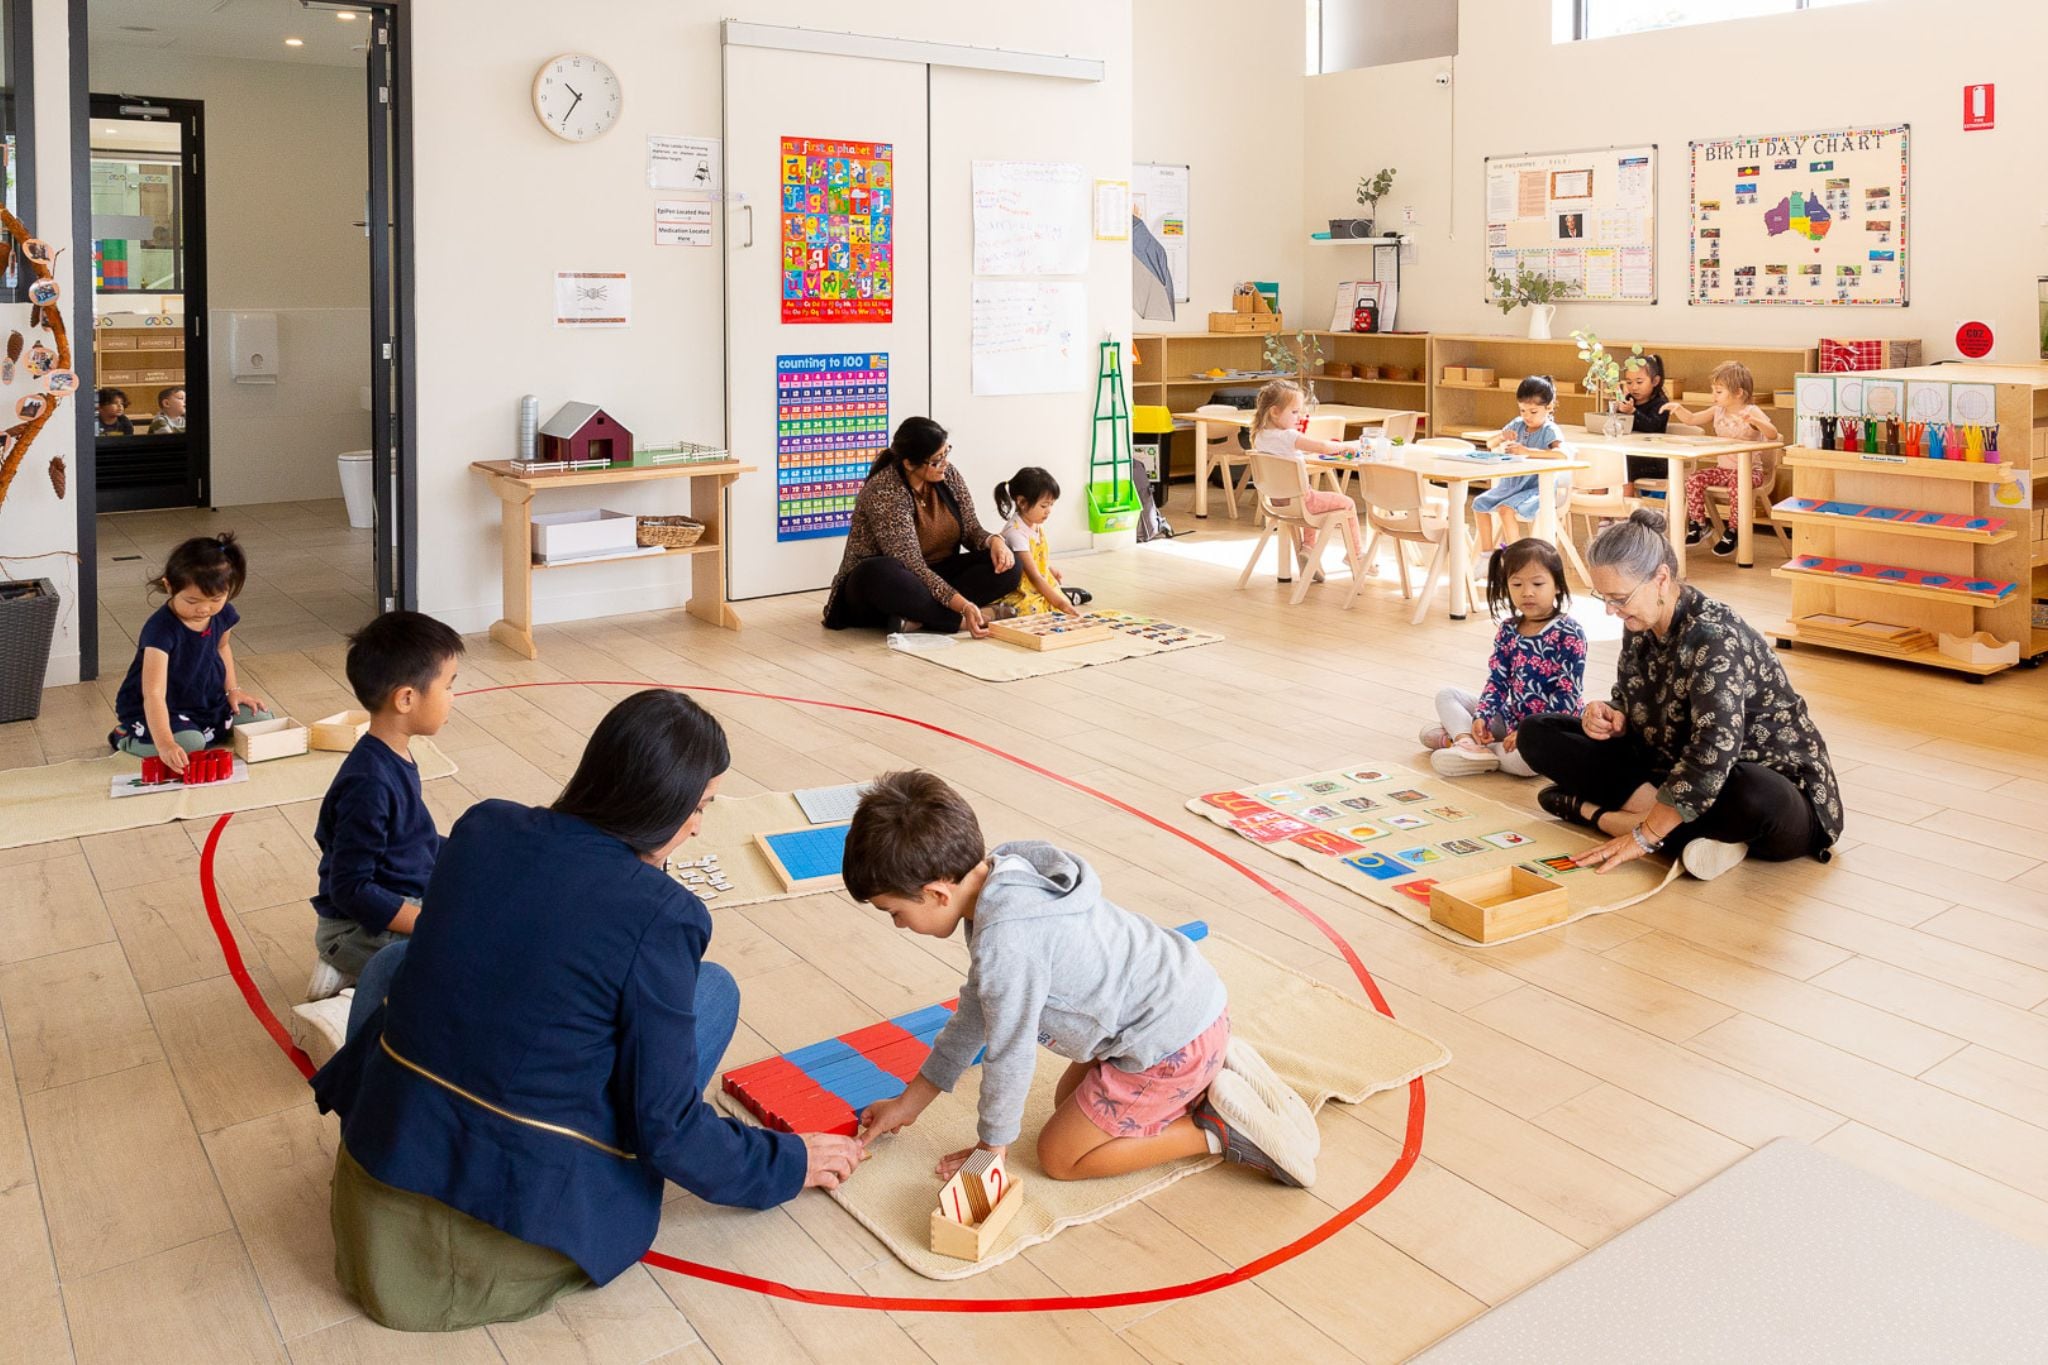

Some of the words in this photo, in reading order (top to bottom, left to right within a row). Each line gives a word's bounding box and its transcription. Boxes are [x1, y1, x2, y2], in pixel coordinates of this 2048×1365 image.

[783, 142, 800, 152] my
[802, 140, 825, 155] first
[828, 143, 870, 156] alphabet
[1813, 134, 1883, 154] CHART
[789, 164, 799, 176] a
[812, 162, 822, 179] b
[856, 167, 867, 184] d
[875, 176, 885, 187] e
[788, 186, 800, 210] f
[810, 195, 821, 213] g
[834, 193, 845, 211] h
[876, 191, 884, 213] j
[791, 218, 802, 235] k
[829, 226, 847, 237] m
[856, 227, 866, 237] n
[812, 250, 825, 268] q
[788, 280, 798, 290] u
[861, 279, 871, 298] y
[1966, 329, 1984, 338] CO2
[778, 357, 826, 372] counting
[829, 357, 840, 367] to
[843, 356, 863, 367] 100
